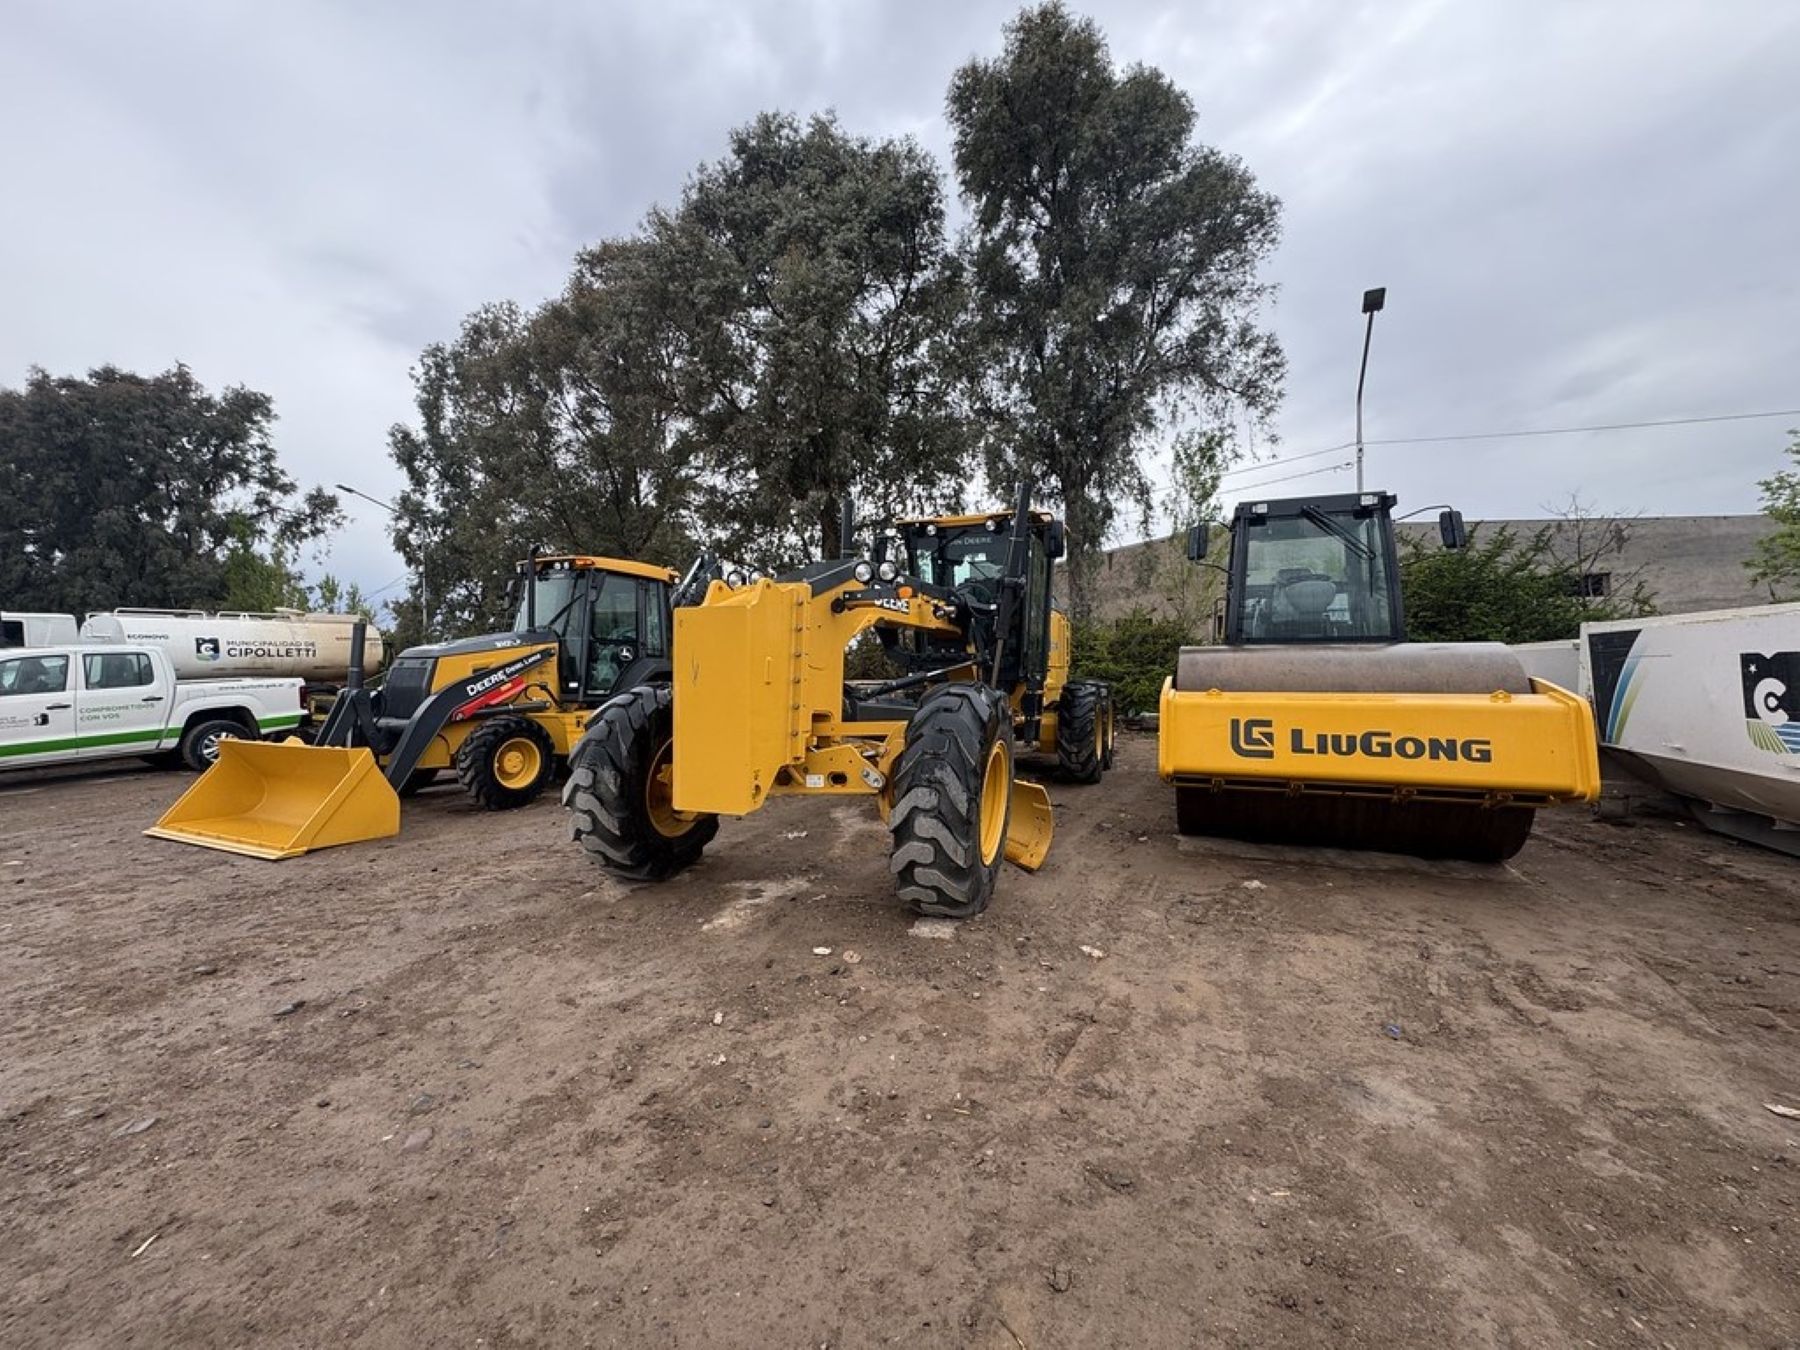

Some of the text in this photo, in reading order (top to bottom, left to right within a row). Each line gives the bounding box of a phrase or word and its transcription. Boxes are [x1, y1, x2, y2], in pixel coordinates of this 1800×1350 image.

[227, 647, 317, 658] CIPOLLETTI
[466, 671, 507, 696] DEERE
[79, 714, 100, 722] CON
[1290, 728, 1492, 763] LIUGONG
